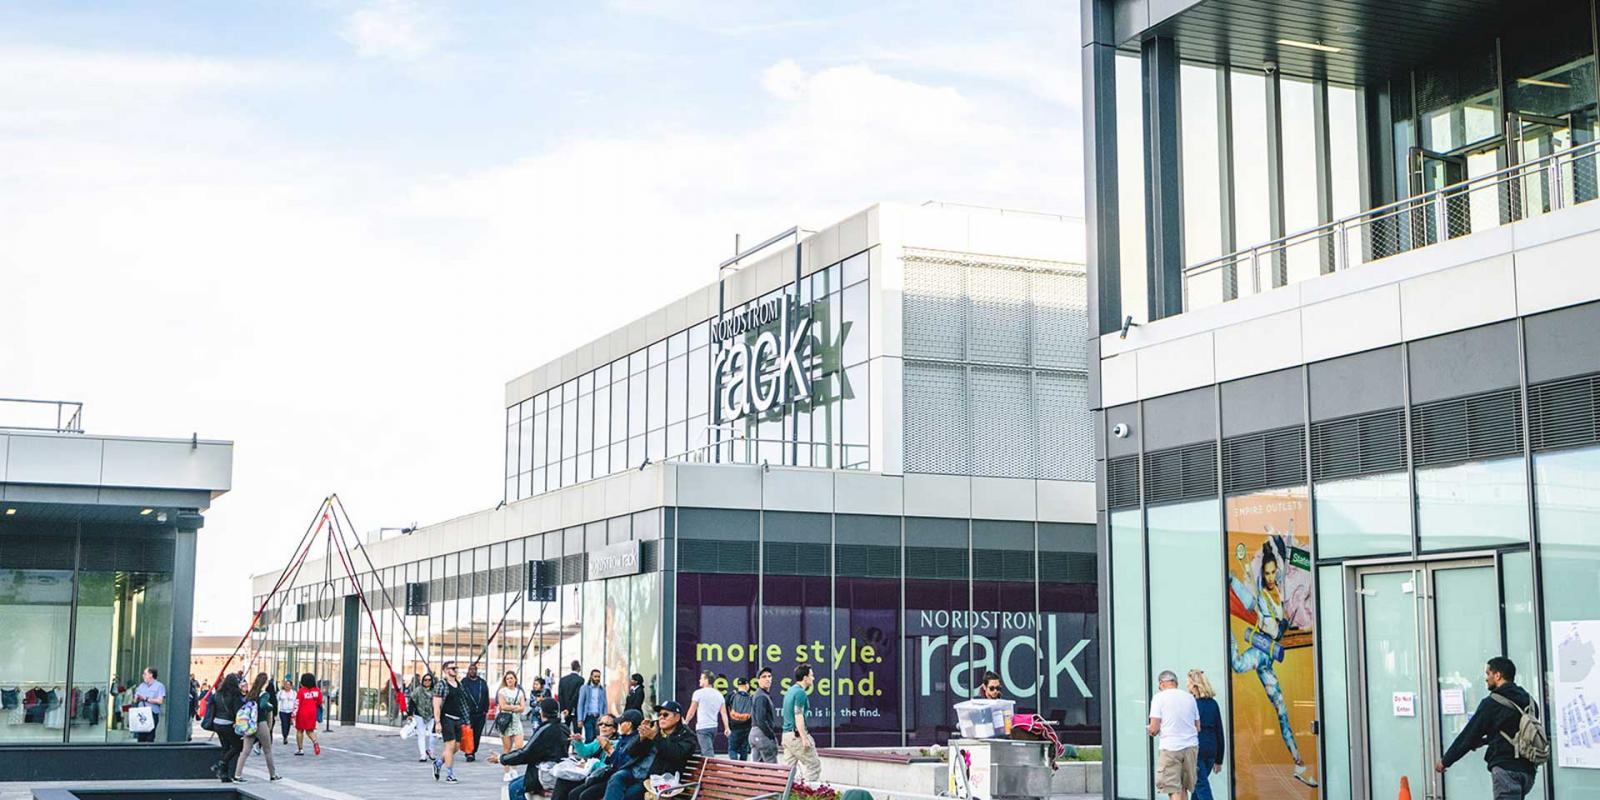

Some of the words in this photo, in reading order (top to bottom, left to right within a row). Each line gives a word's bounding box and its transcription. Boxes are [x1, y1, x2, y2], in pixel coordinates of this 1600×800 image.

[711, 299, 780, 343] NORDSTROM
[710, 294, 811, 425] rack
[1232, 506, 1262, 517] EMPIRE
[1265, 501, 1303, 513] OUTLETS
[921, 610, 1042, 631] NORDSTROM
[696, 643, 782, 662] more
[795, 638, 882, 671] style.
[921, 614, 1093, 698] rack
[815, 708, 823, 717] is
[840, 708, 857, 717] the
[859, 708, 881, 717] find.
